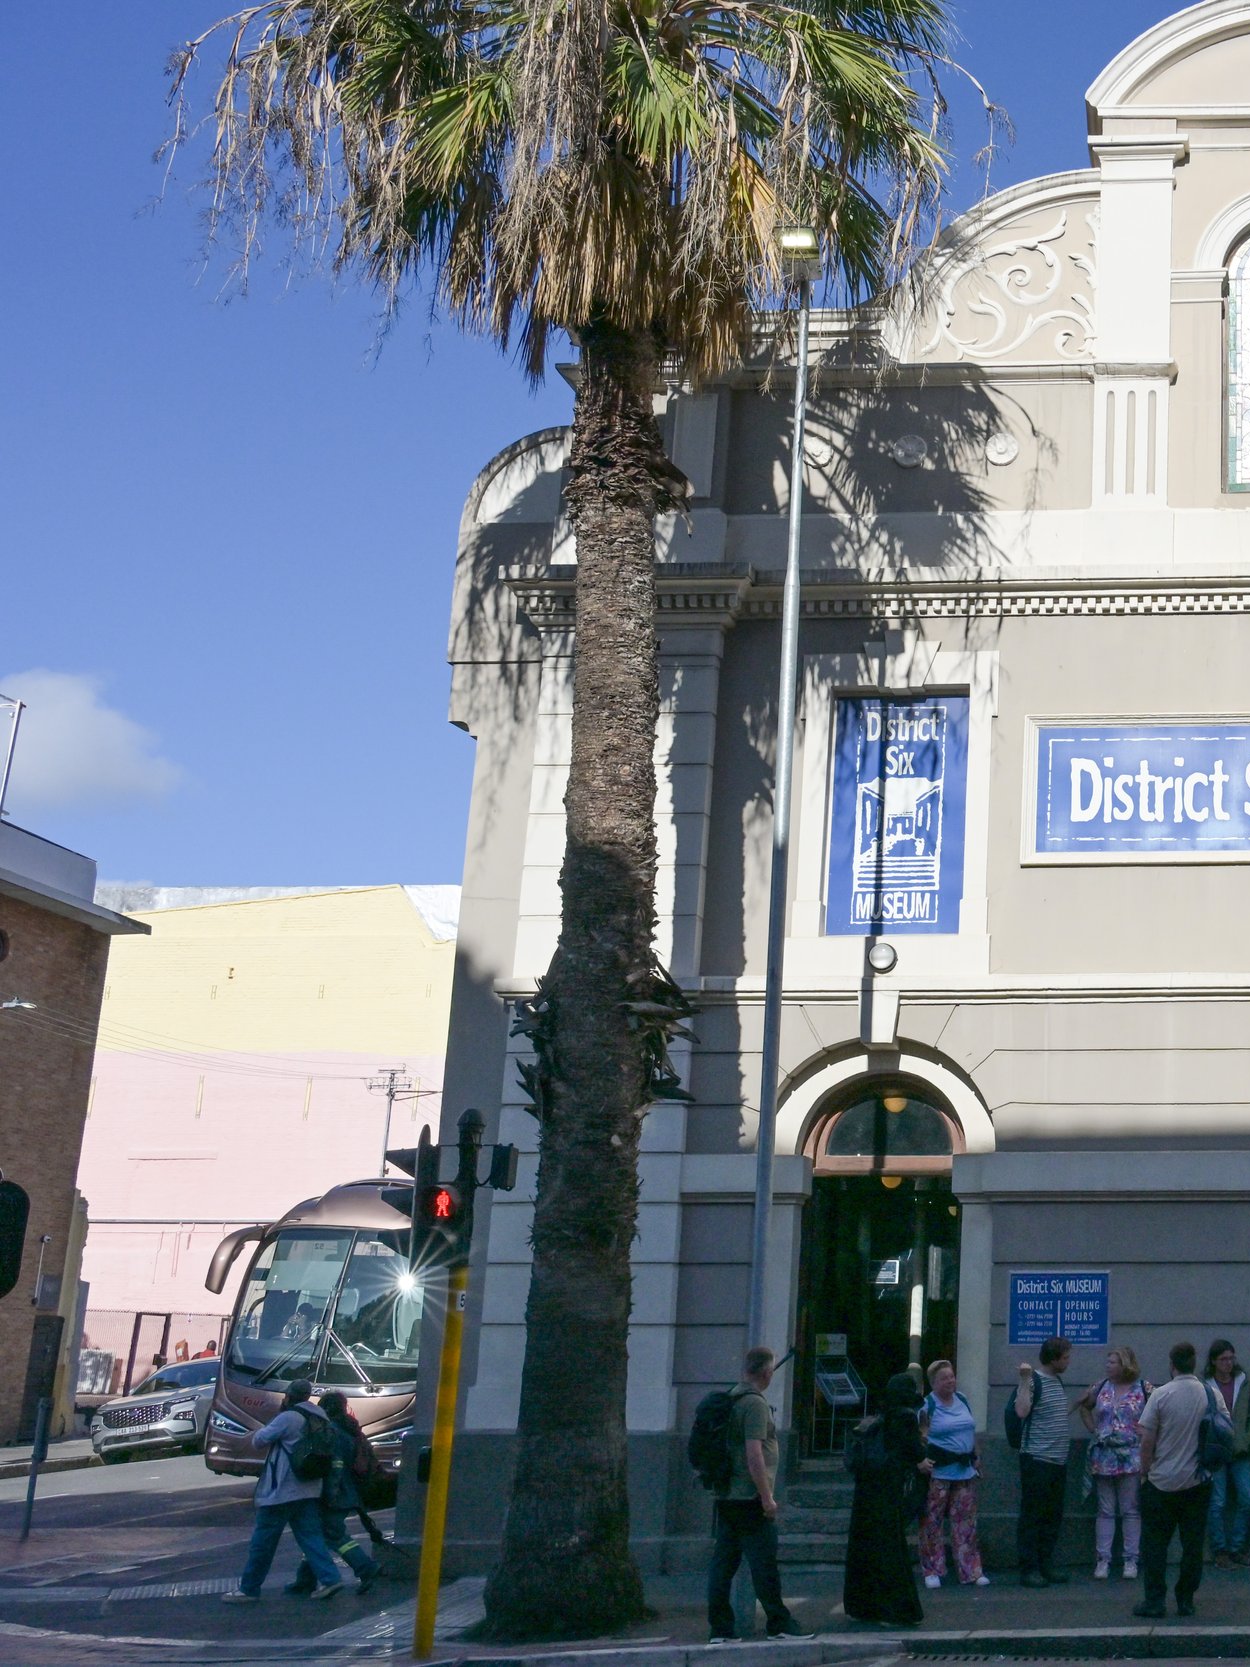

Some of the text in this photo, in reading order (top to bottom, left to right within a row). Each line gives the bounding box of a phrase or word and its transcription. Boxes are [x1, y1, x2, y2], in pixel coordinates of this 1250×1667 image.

[865, 711, 940, 743] District
[884, 744, 915, 776] Six
[1069, 756, 1231, 824] District
[855, 891, 930, 920] MUSEUM
[1017, 1279, 1102, 1294] District Six MUSEUM
[1018, 1301, 1054, 1311] CONTACT
[1064, 1311, 1094, 1321] HOURS
[1065, 1301, 1100, 1310] OPENING
